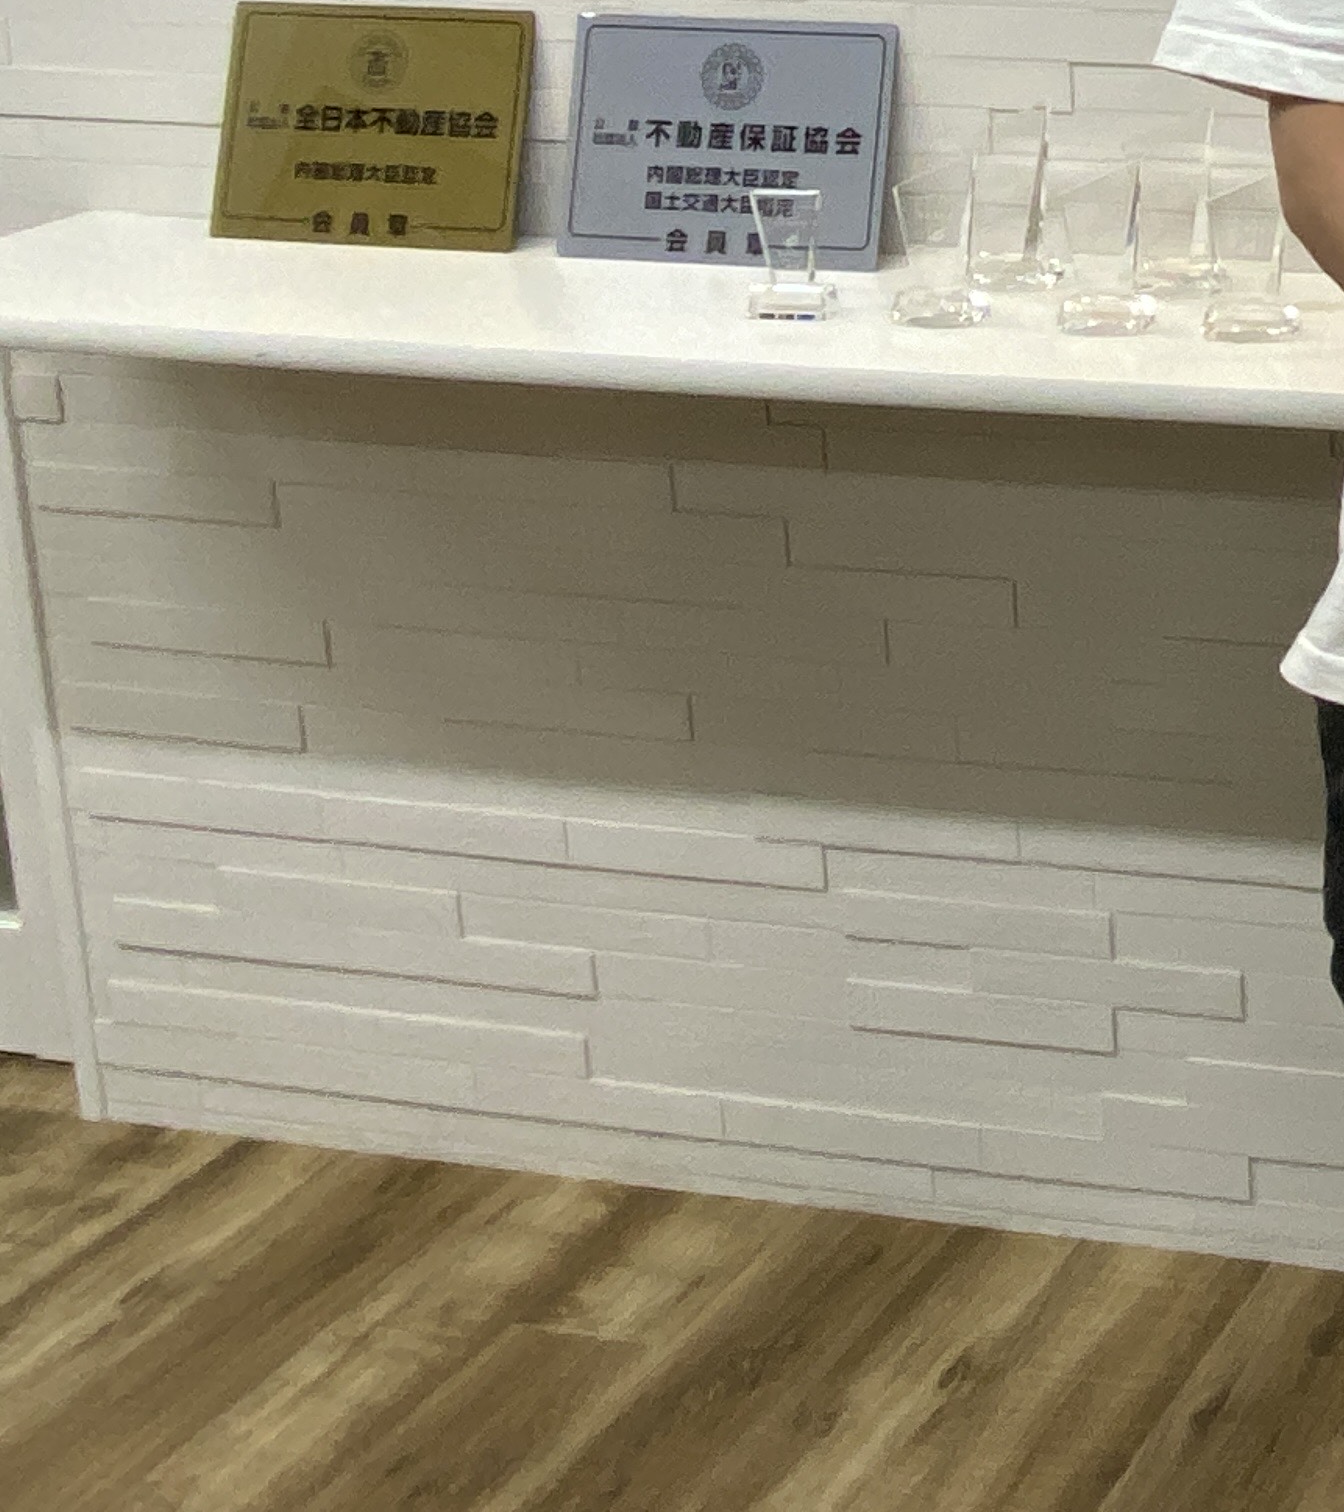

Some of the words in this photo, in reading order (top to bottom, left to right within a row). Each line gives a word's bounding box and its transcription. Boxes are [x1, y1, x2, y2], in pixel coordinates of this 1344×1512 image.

[294, 104, 499, 139] 全日本不動産協会
[645, 119, 863, 155] 不動産保証協会
